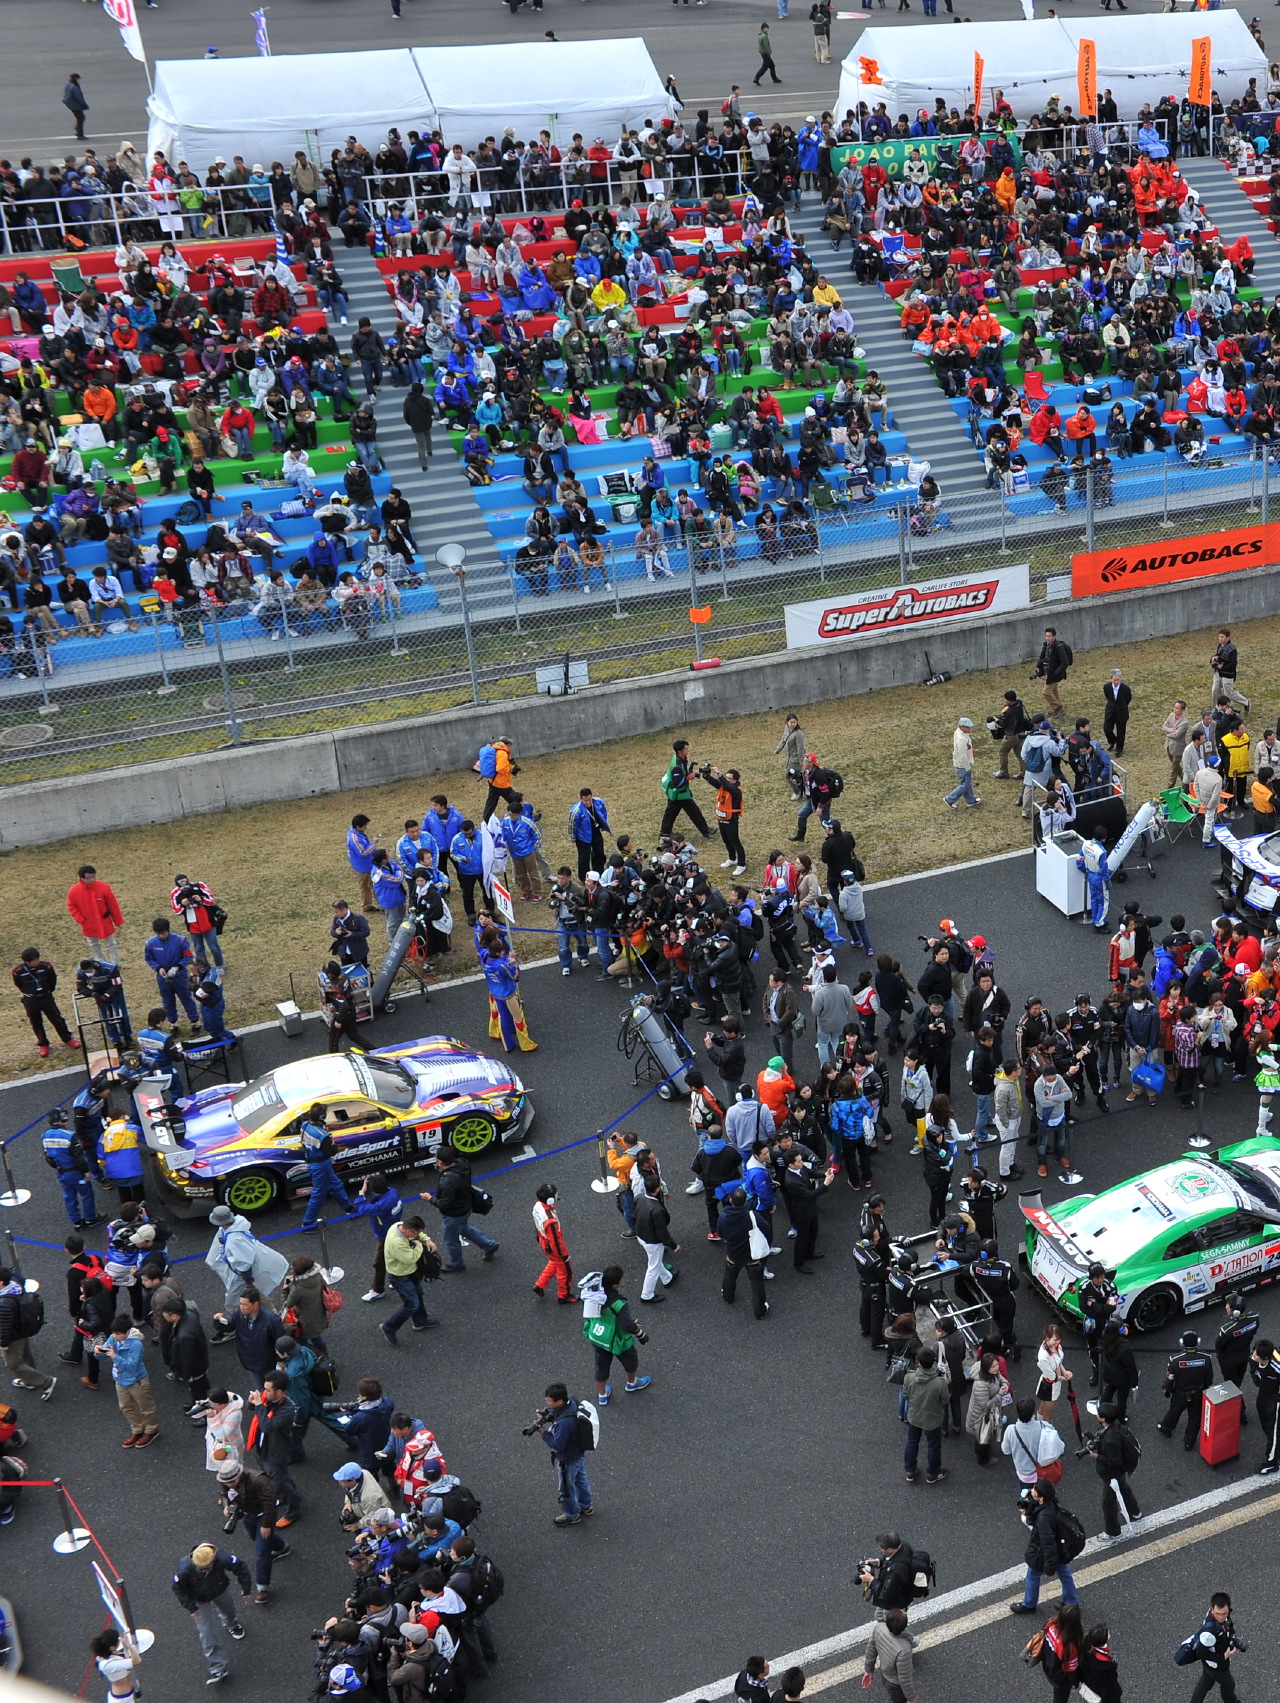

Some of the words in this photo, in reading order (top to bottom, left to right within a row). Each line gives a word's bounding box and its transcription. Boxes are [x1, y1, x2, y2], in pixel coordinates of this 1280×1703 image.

[839, 145, 895, 163] JOAO
[1129, 539, 1263, 574] AUTOBACS
[857, 592, 889, 604] CREATIVE
[921, 582, 948, 593] CARLIFE
[948, 579, 969, 590] STORE
[1114, 819, 1139, 854] EPSON
[1216, 835, 1268, 871] EPSON
[498, 894, 508, 911] 19
[421, 1129, 437, 1140] 19
[347, 1150, 399, 1168] YOKOHAMA
[385, 1164, 411, 1174] TAKATA
[1033, 1210, 1091, 1266] ADVAN
[1226, 1267, 1260, 1284] YOKOHAMA
[592, 1323, 605, 1336] 19
